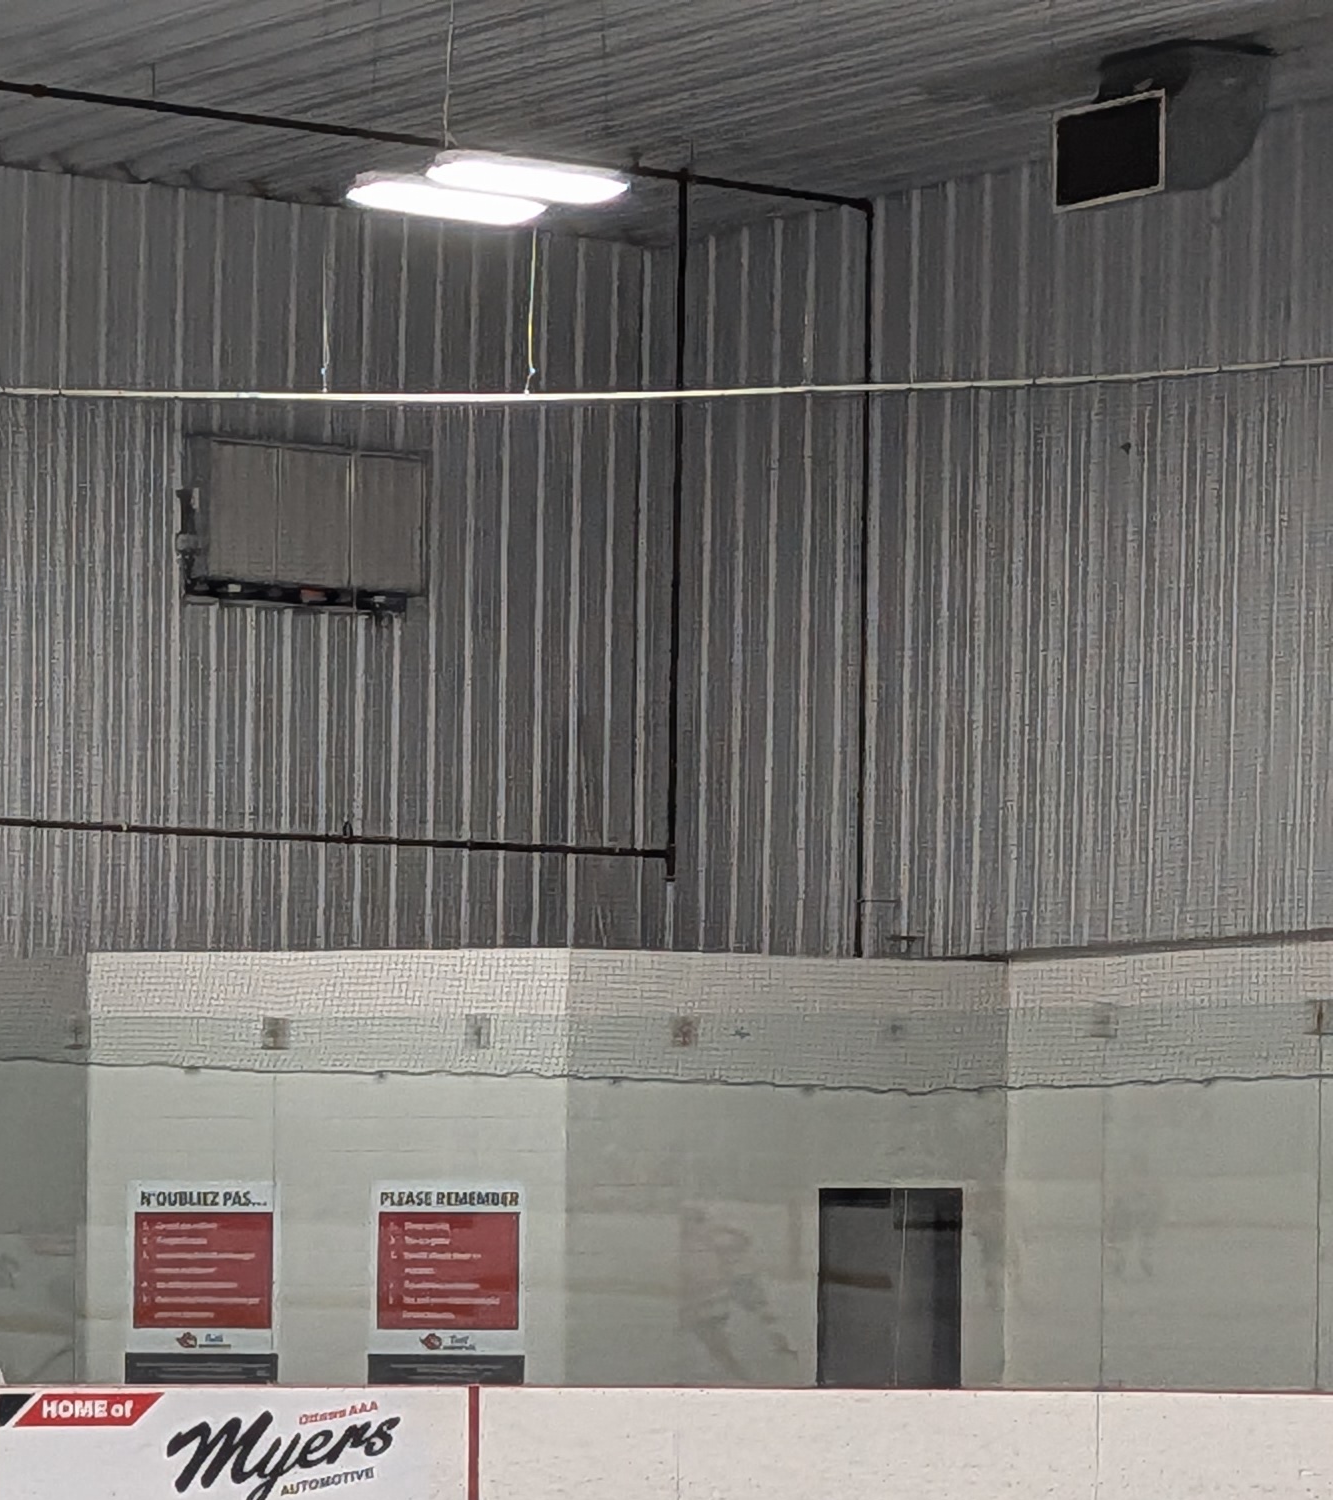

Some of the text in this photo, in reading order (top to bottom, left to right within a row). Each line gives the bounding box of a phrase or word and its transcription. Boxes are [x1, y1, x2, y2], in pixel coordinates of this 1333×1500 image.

[380, 1191, 519, 1206] PLEASE REMEMBER
[42, 1400, 132, 1418] HOME of
[349, 1400, 379, 1416] AAA
[280, 1466, 375, 1496] AUTOMOTIVE
